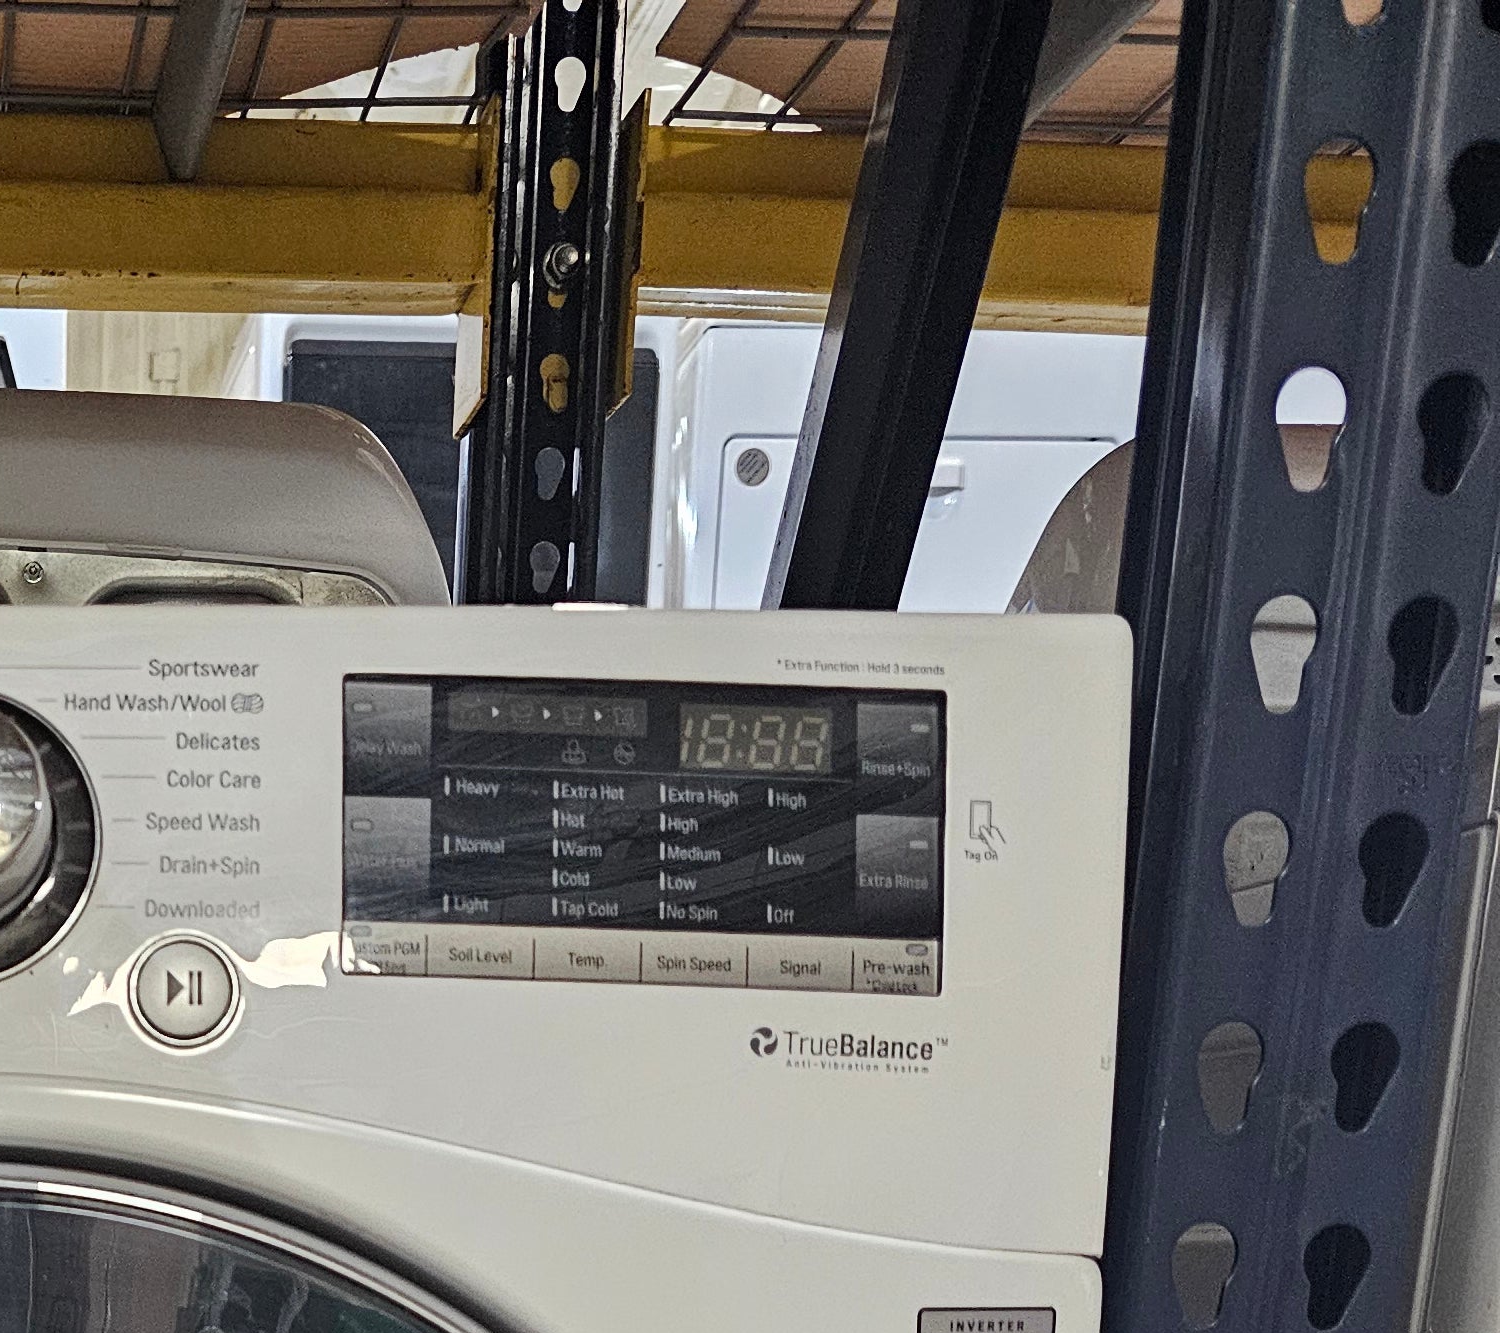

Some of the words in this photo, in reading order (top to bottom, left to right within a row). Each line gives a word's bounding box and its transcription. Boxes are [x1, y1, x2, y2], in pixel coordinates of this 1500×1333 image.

[148, 658, 260, 680] Sportswear
[784, 659, 812, 671] Extra
[867, 662, 891, 674] Hold
[902, 664, 946, 676] seconds
[63, 693, 111, 712] Hand
[116, 693, 226, 712] Wash/Wool
[176, 731, 261, 751] Delicates
[167, 769, 214, 789] Color
[219, 769, 261, 789] Care
[455, 778, 500, 797] Heavy
[561, 784, 598, 800] Extra
[601, 785, 625, 801] Hot
[668, 786, 705, 804] Extra
[708, 788, 739, 809] High
[775, 791, 807, 812] High
[146, 812, 203, 834] Speed
[208, 812, 261, 832] Wash
[561, 811, 586, 829] Hot
[668, 816, 699, 835] High
[454, 837, 506, 854] Normal
[561, 842, 603, 858] Warm
[667, 844, 722, 862] Medium
[775, 848, 806, 866] Low
[964, 849, 982, 863] Tag
[159, 854, 261, 878] Drain+Spin
[560, 869, 591, 887] Cold
[667, 875, 698, 891] Low
[858, 872, 893, 889] Extra
[144, 899, 261, 919] Downloaded
[561, 902, 585, 918] Tap
[588, 903, 619, 918] Cold
[666, 905, 686, 920] No
[688, 905, 718, 923] Spin
[773, 908, 795, 924] Off
[353, 941, 391, 955] ustom
[449, 948, 476, 963] Soil
[477, 949, 513, 965] Level
[657, 955, 687, 973] Spin
[689, 956, 732, 974] Speed
[779, 959, 822, 977] Signal
[863, 959, 930, 977] Pre-wash
[950, 1319, 1024, 1332] INVERTER
